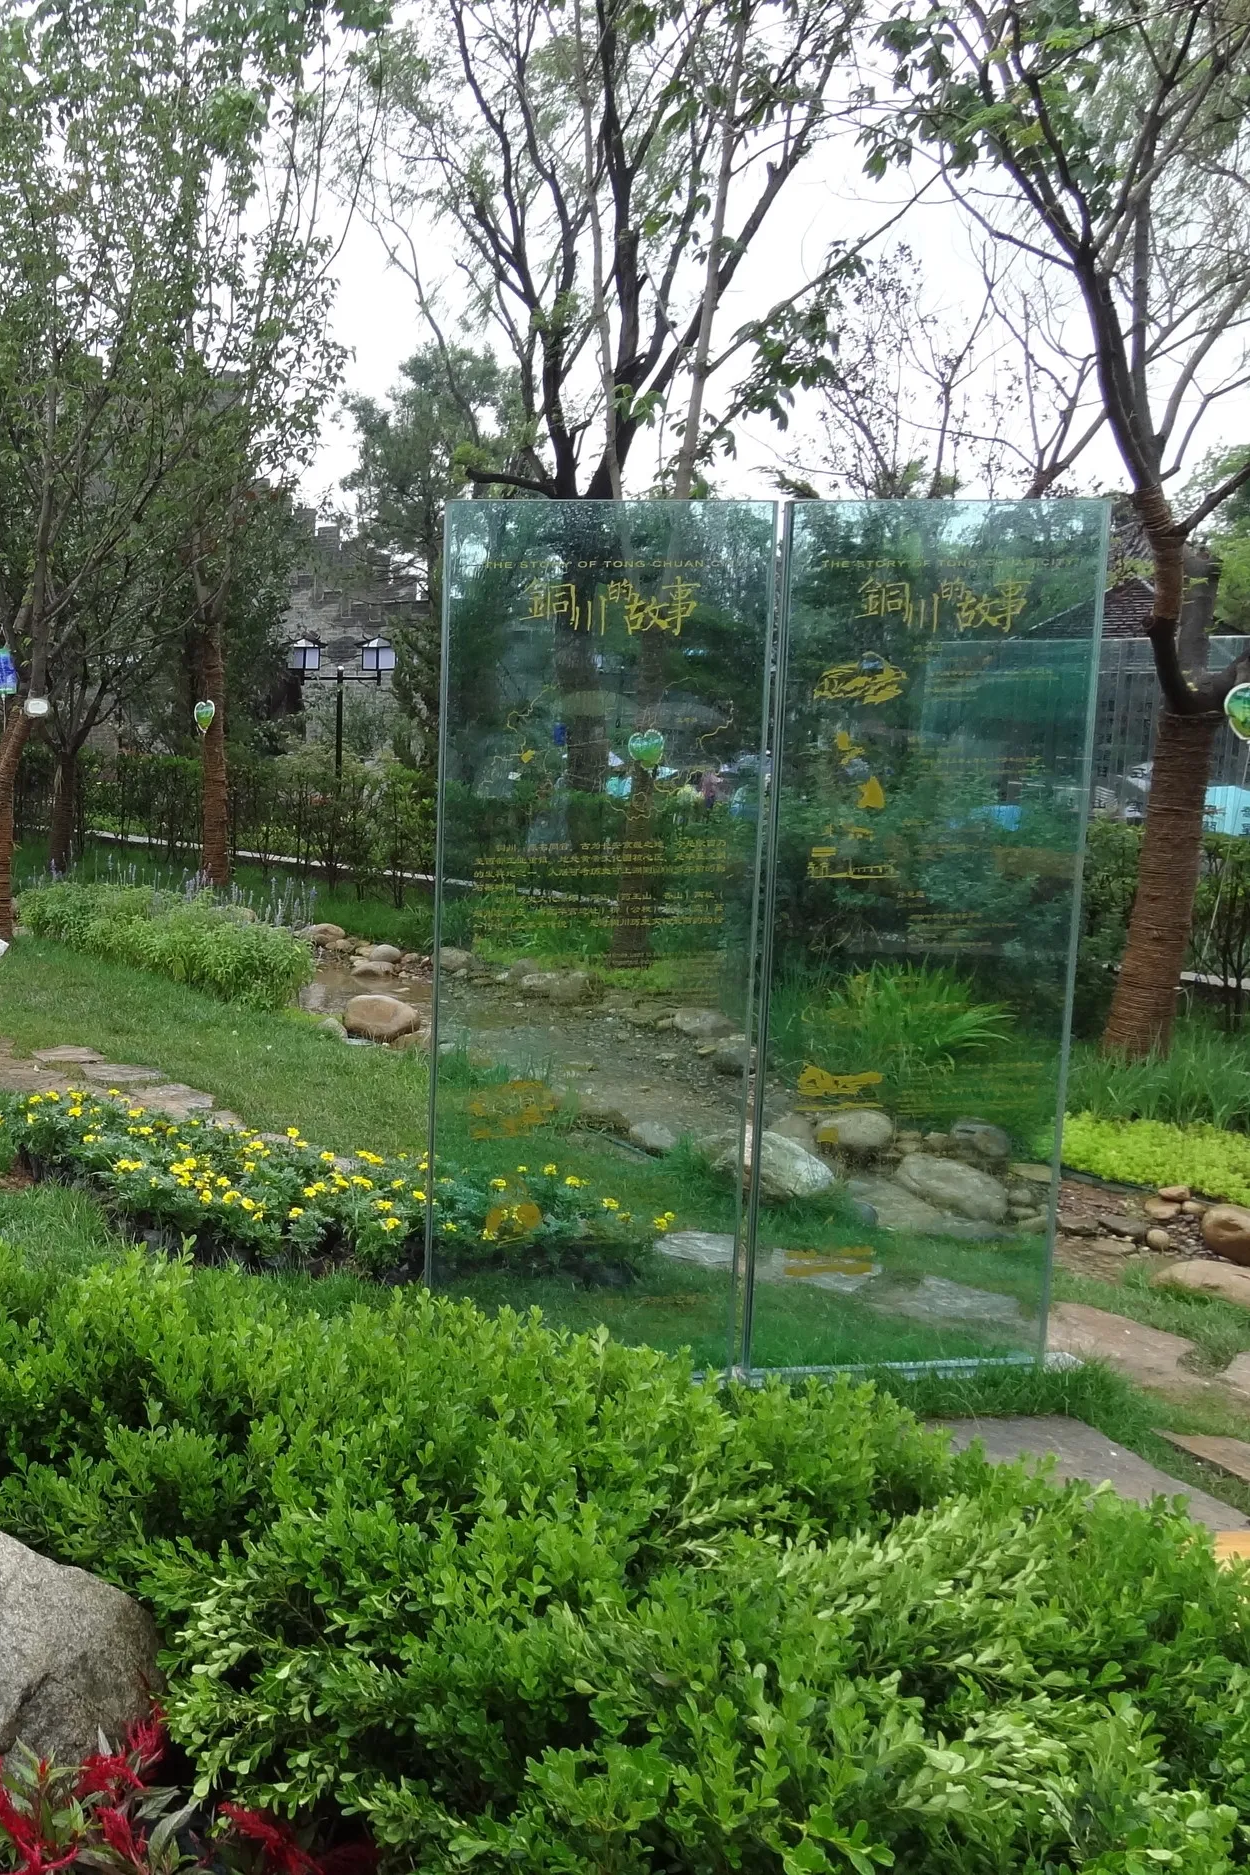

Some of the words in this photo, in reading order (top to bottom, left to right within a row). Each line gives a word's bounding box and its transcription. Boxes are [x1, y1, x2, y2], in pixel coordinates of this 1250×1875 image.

[485, 560, 513, 569] THE
[578, 560, 597, 568] OF
[603, 560, 646, 568] TONG
[652, 559, 704, 568] CHUAN
[821, 560, 851, 569] THE
[856, 560, 906, 568] STORY
